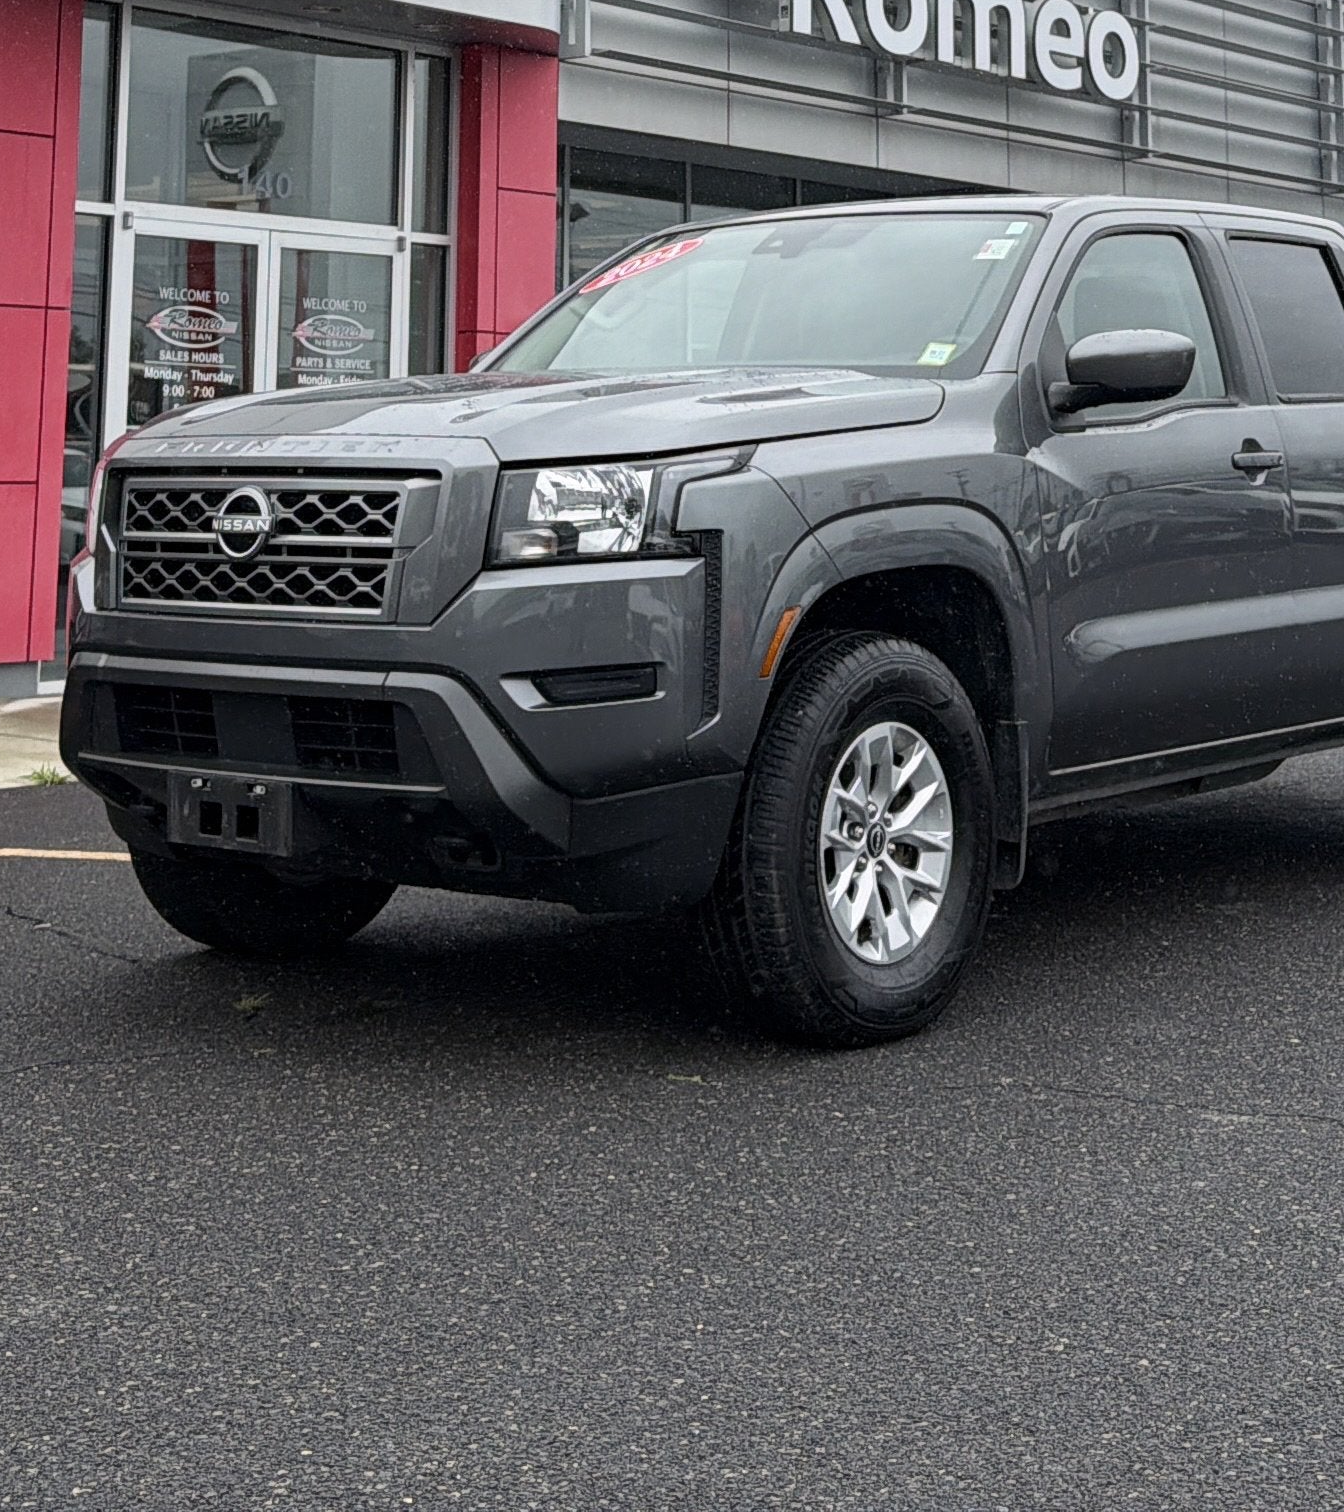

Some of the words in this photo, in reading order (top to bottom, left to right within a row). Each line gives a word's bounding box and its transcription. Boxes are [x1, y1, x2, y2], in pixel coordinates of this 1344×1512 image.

[238, 165, 292, 199] 140
[159, 287, 212, 303] WELCOME
[214, 291, 230, 304] TO
[303, 297, 350, 311] WELCOME
[352, 300, 367, 312] TO
[164, 309, 224, 330] Romeo
[171, 330, 213, 341] NISSAN
[315, 339, 353, 348] NISSAN
[159, 350, 189, 361] SALES
[191, 352, 224, 363] HOURS
[296, 356, 323, 367] PARTS
[326, 358, 332, 367] &
[335, 359, 371, 369] SERVICE
[144, 367, 182, 383] Monday
[191, 369, 234, 385] Thursday
[298, 373, 333, 385] Monday
[212, 518, 271, 531] NISSAN
